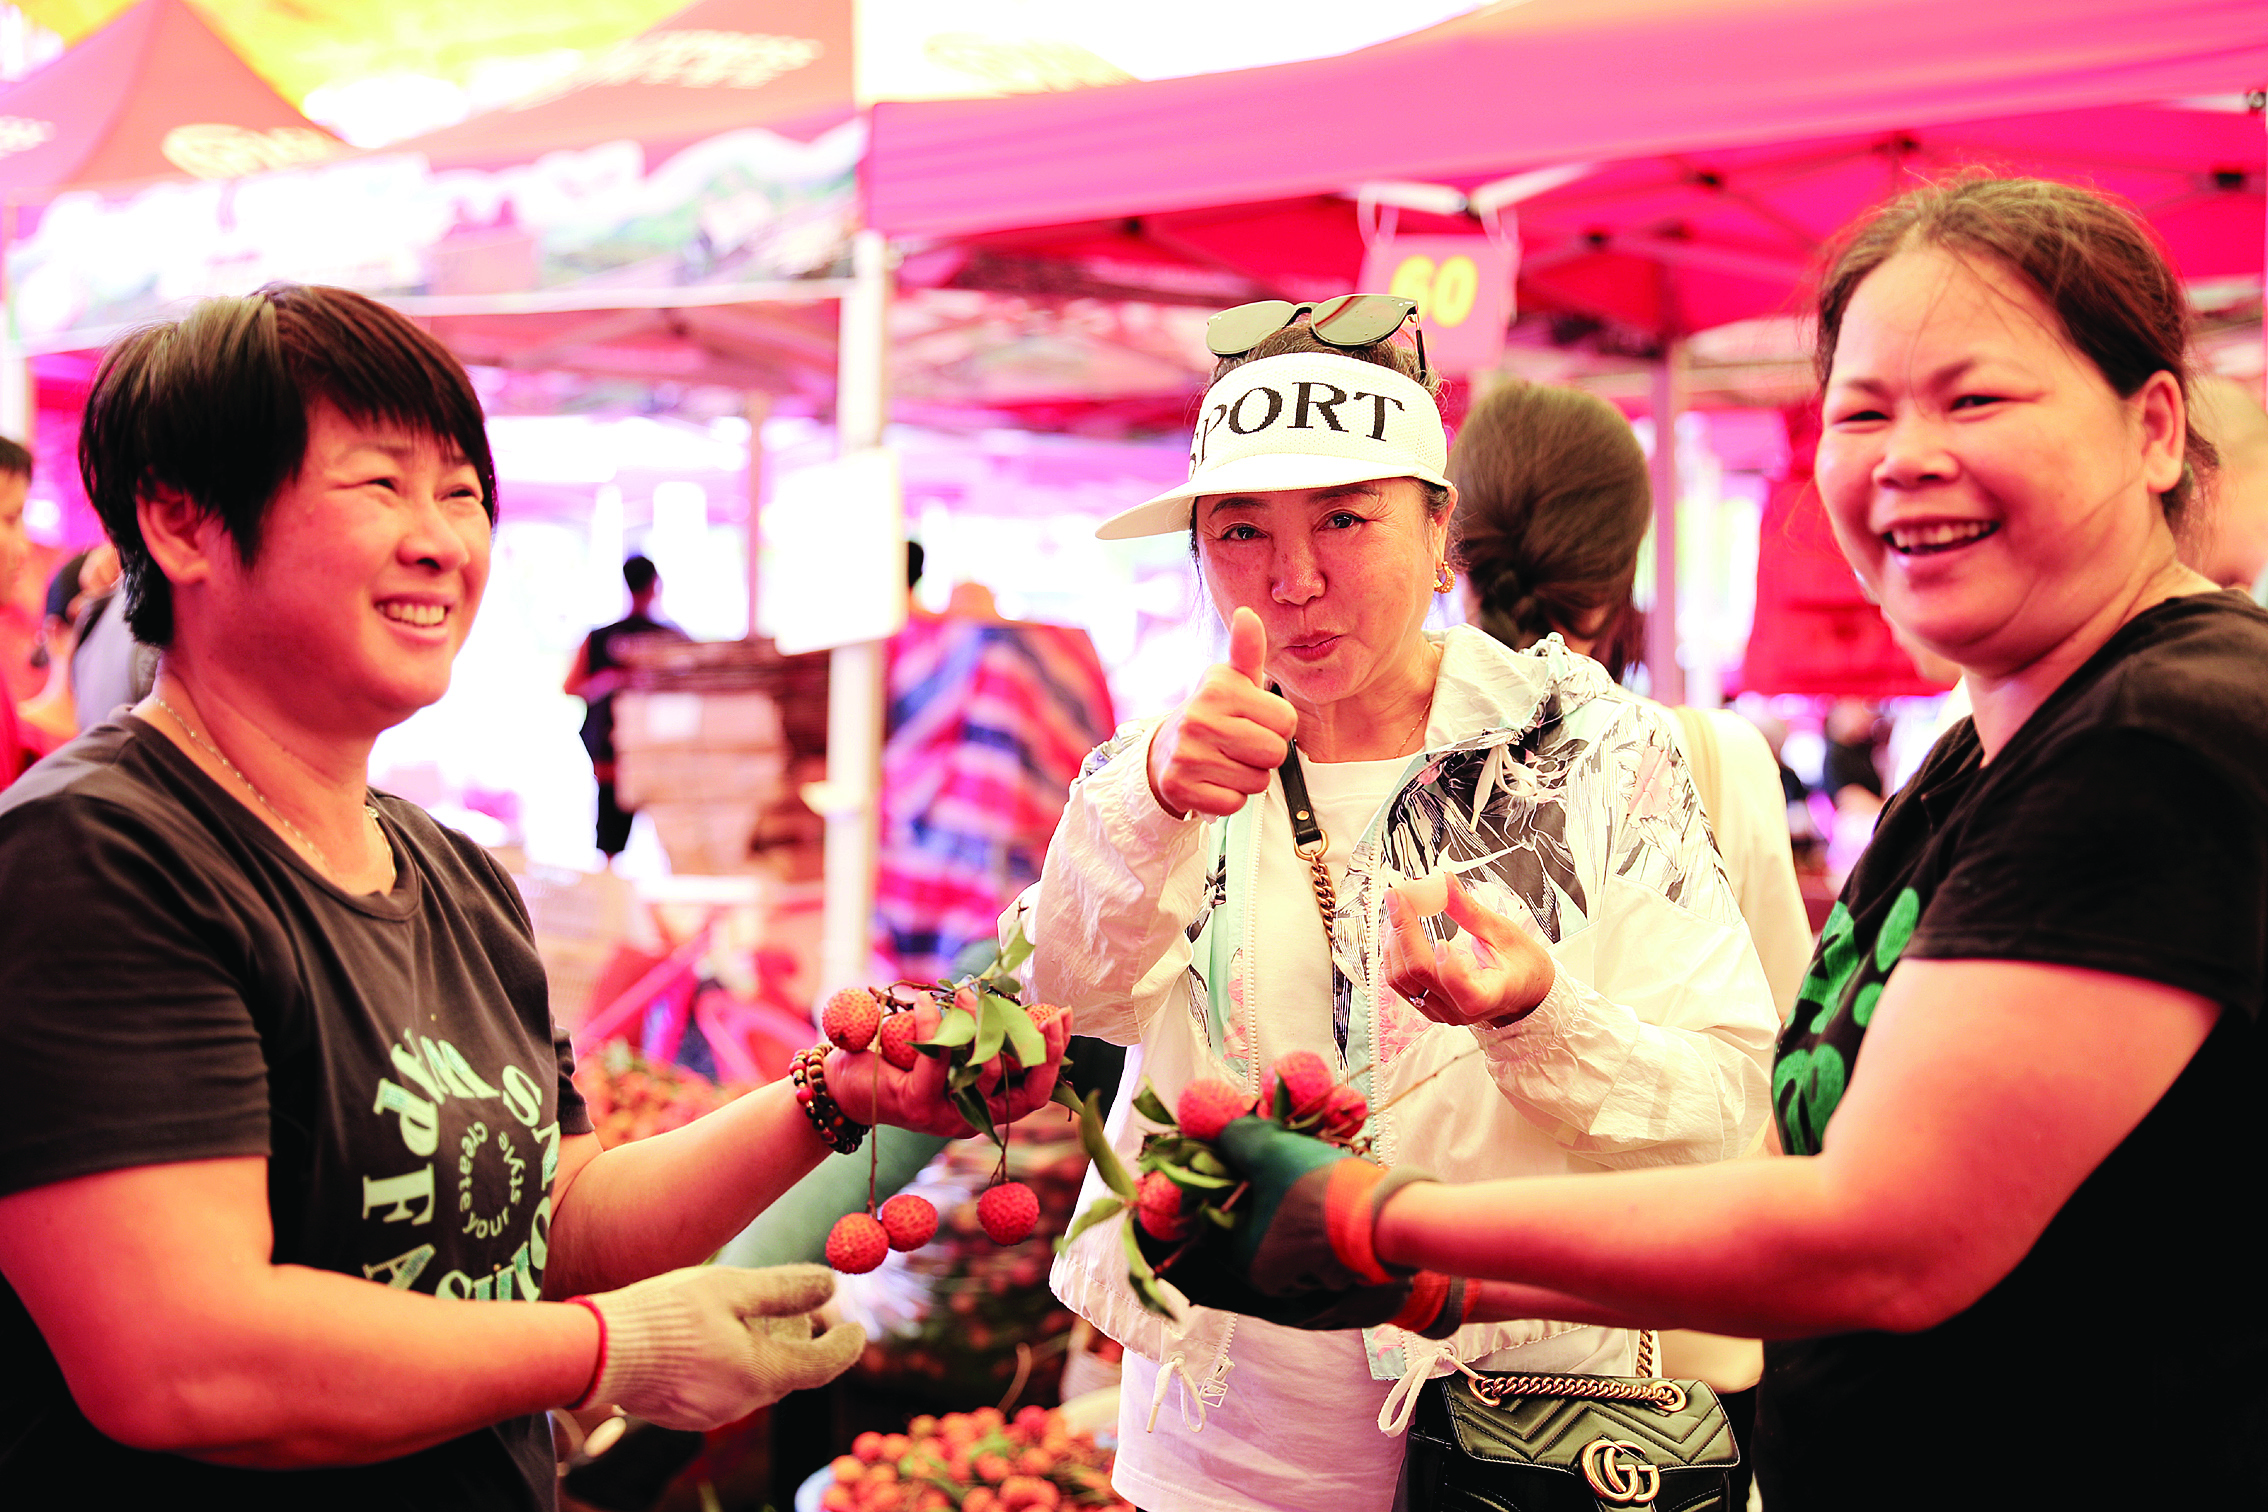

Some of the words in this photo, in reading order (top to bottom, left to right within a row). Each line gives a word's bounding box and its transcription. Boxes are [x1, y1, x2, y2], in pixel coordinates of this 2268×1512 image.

[1388, 253, 1479, 328] 60
[459, 1121, 489, 1212] create
[498, 1130, 526, 1205] style
[462, 1205, 510, 1239] your
